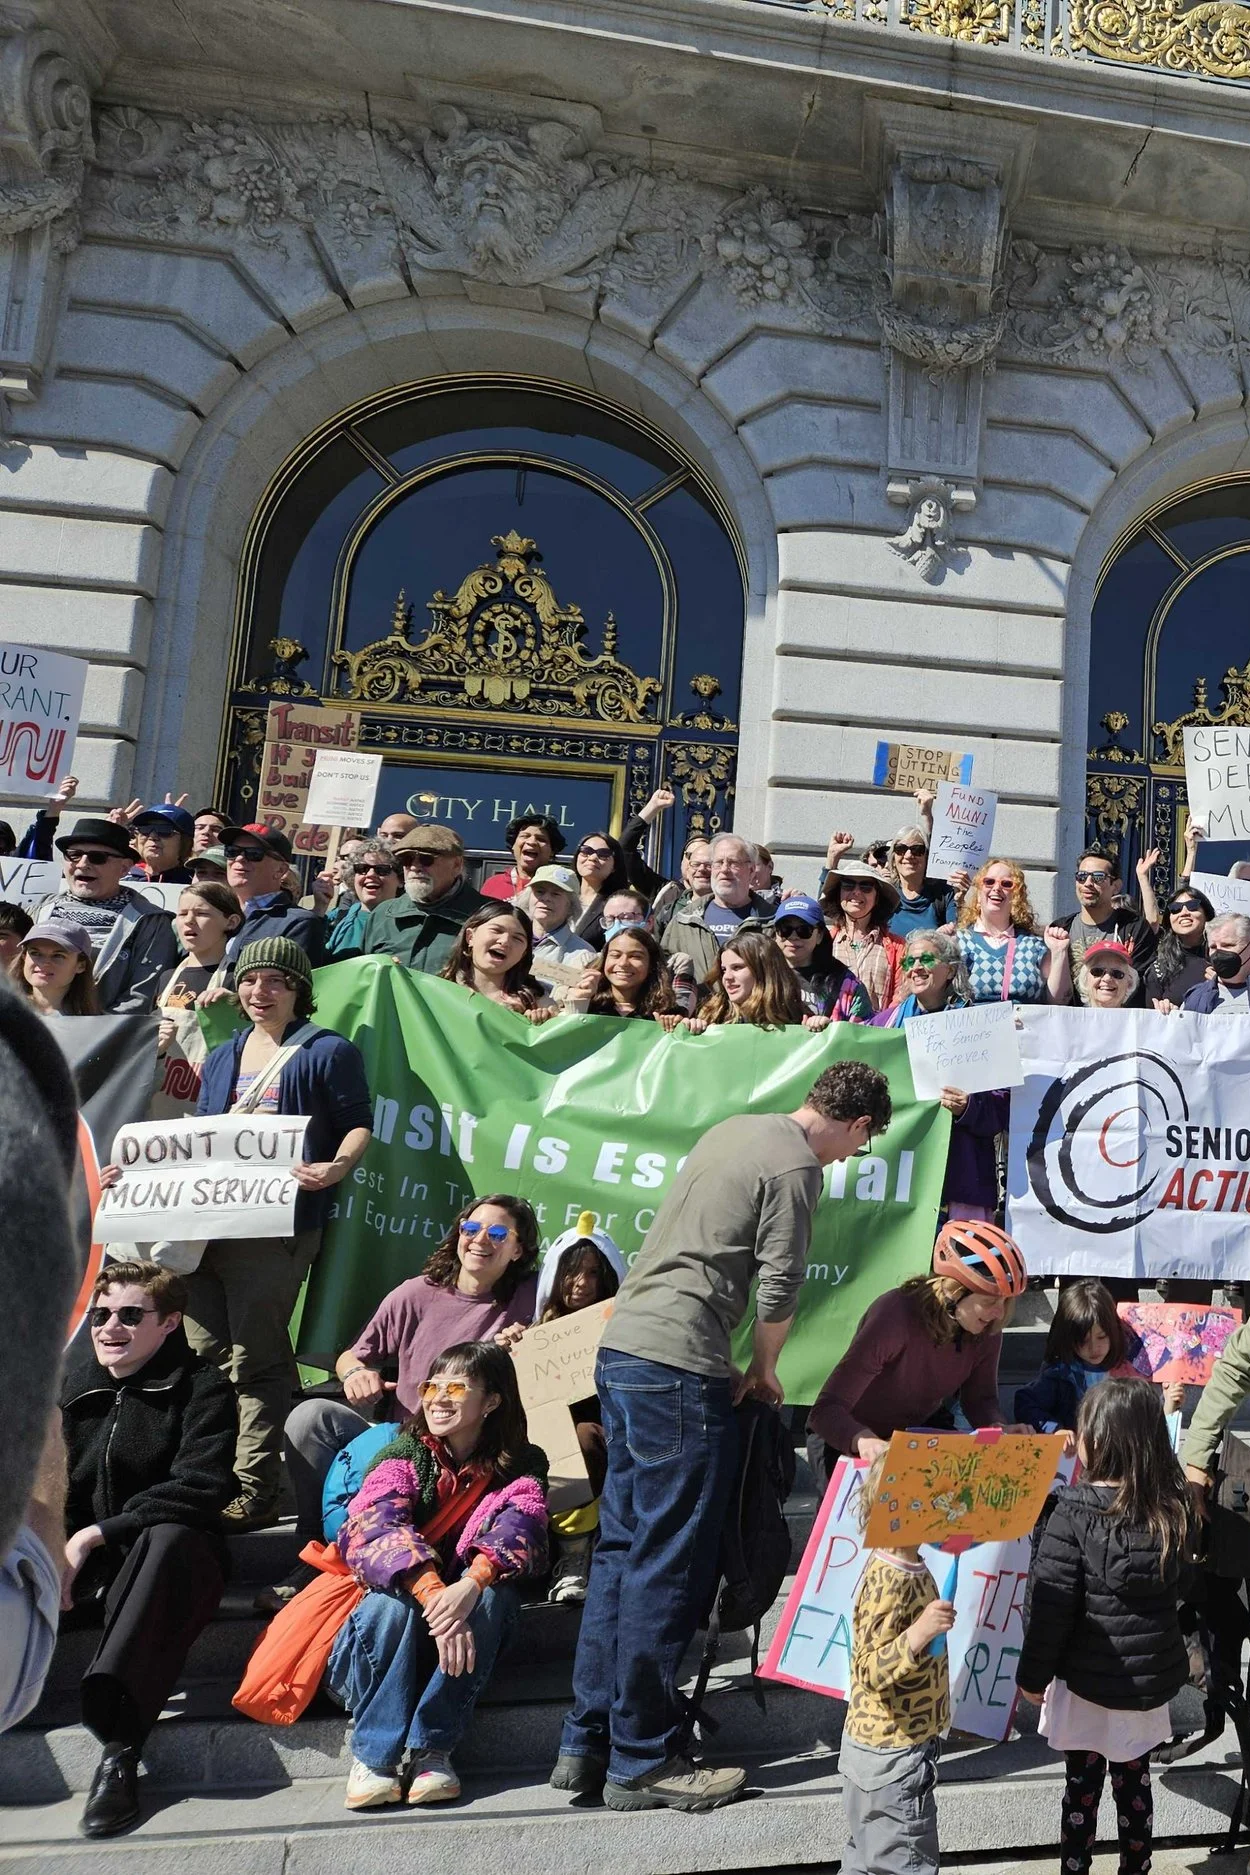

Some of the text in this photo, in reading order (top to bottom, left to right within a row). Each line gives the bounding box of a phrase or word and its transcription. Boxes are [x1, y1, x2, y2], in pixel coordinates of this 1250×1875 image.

[270, 703, 357, 747] Transit:
[906, 747, 944, 762] STOP
[266, 767, 310, 789] bui
[888, 757, 960, 777] CUTTING
[887, 773, 938, 792] SERVI
[263, 790, 299, 809] we
[405, 793, 484, 821] CITY
[945, 802, 989, 826] MUNI
[956, 826, 974, 838] the
[1203, 881, 1249, 902] MUNI
[120, 1128, 304, 1166] DONT CUT
[503, 1123, 571, 1175] Is
[100, 1179, 185, 1212] MUNI
[190, 1177, 295, 1207] SERVICE
[400, 1175, 428, 1201] In
